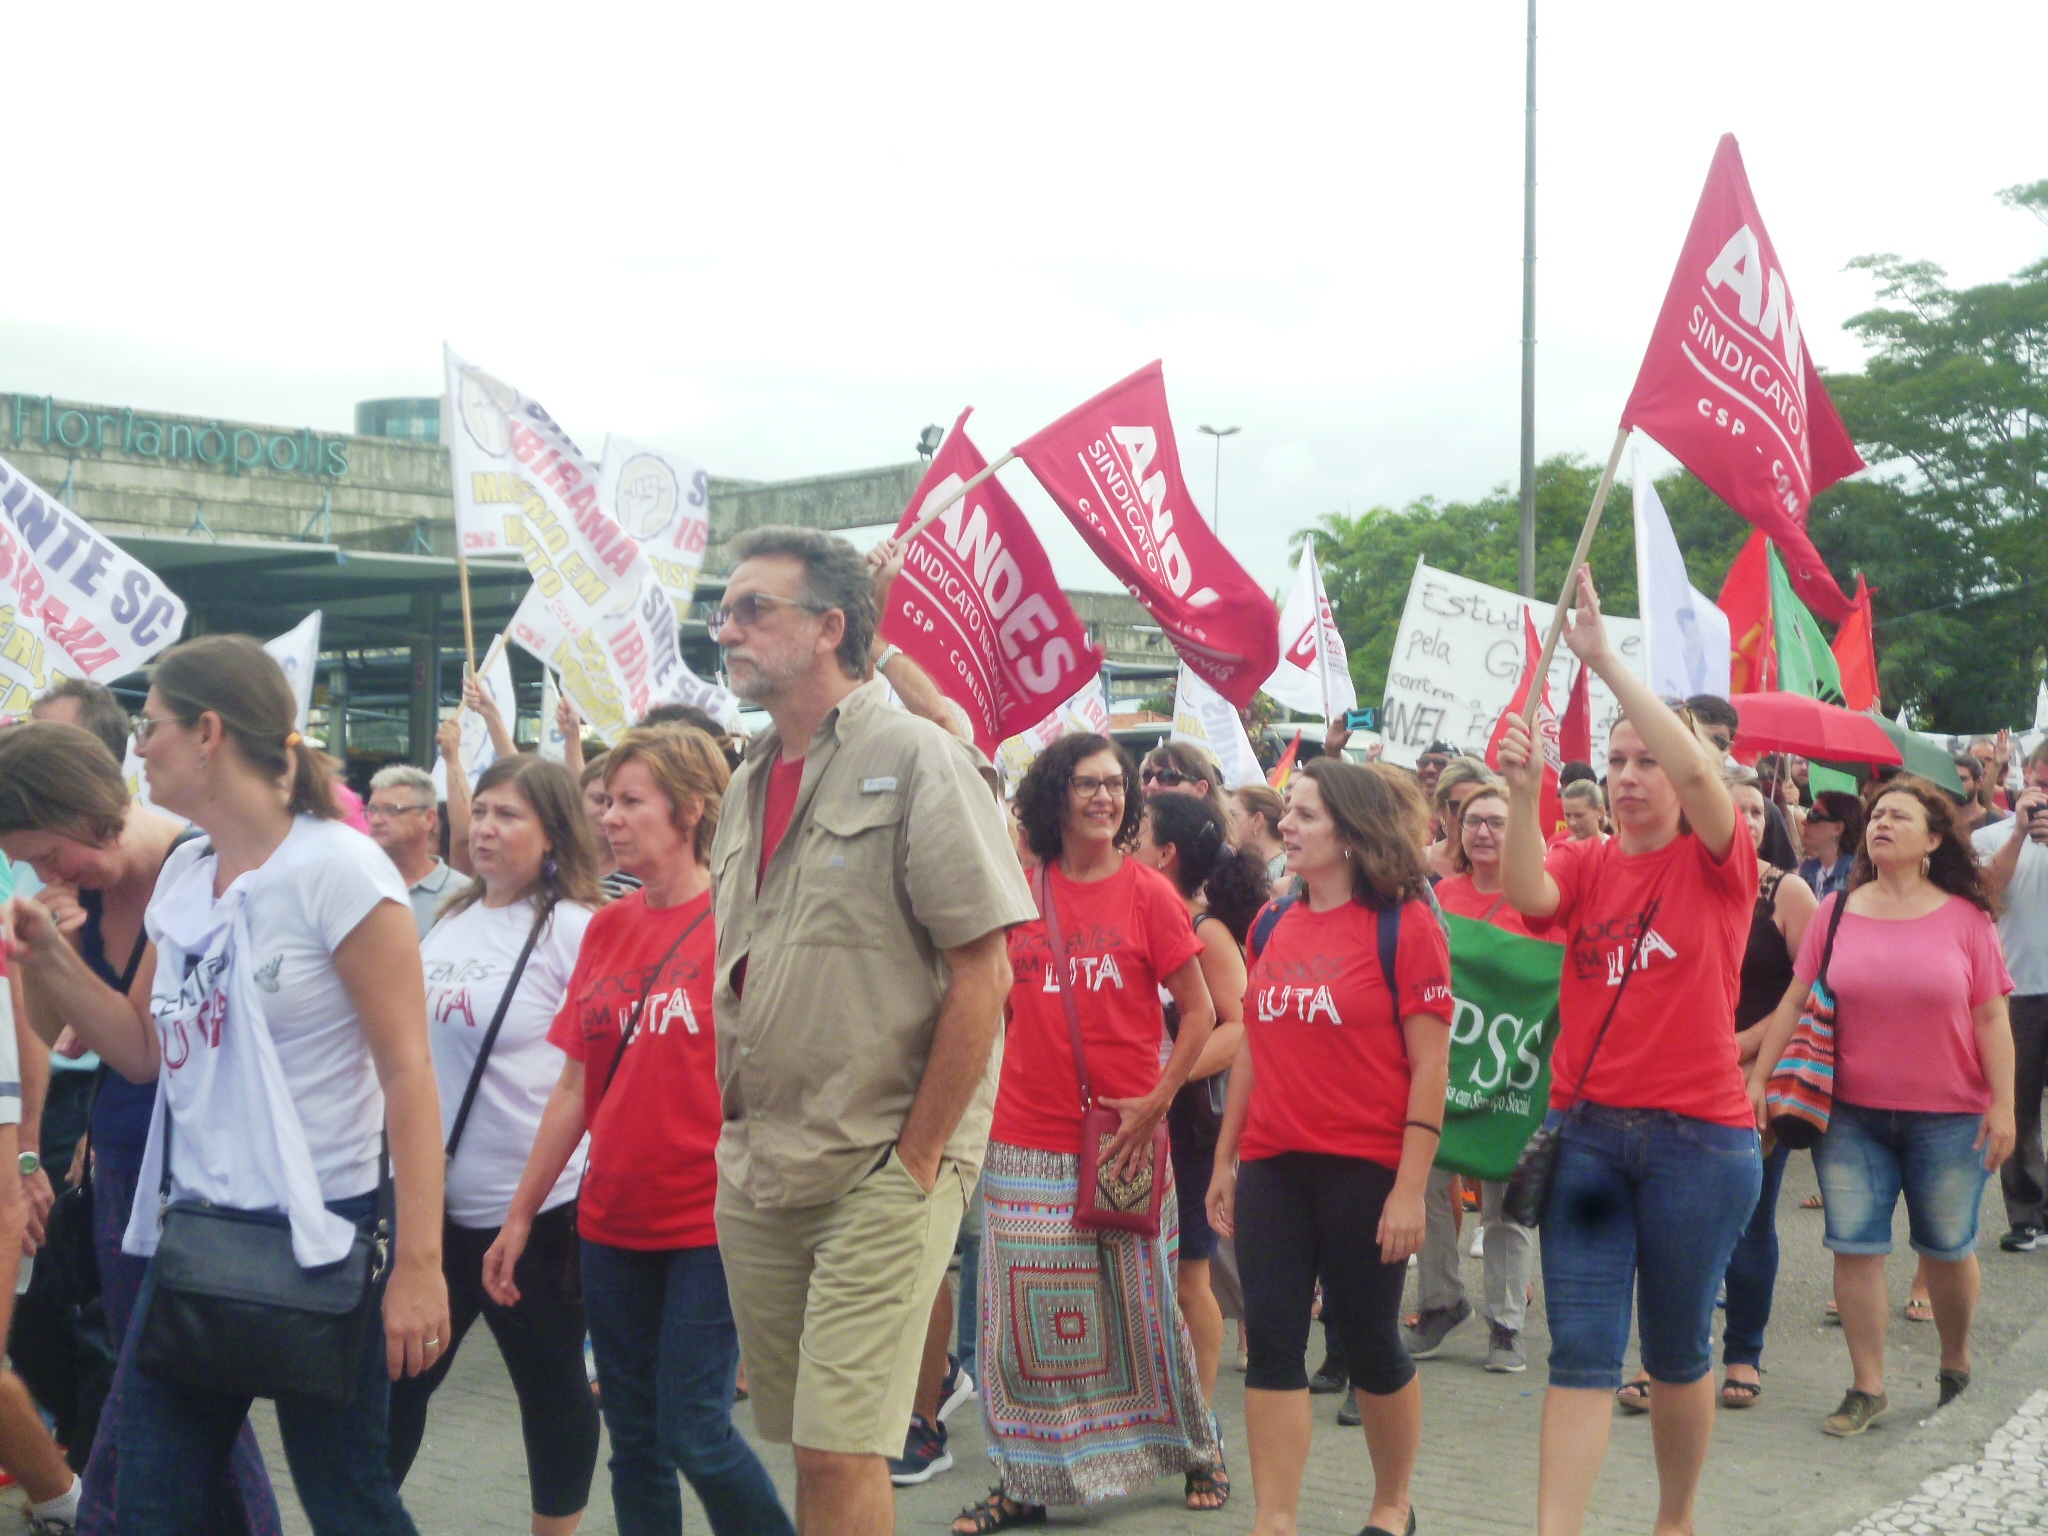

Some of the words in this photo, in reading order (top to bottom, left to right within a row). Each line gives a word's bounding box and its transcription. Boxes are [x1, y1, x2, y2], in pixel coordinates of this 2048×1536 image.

[1688, 304, 1800, 435] SINDICATO
[11, 394, 349, 478] Florianópolis
[1698, 398, 1746, 436] CSP
[1088, 440, 1158, 573] SINDICATO
[110, 569, 174, 647] SC
[1406, 627, 1450, 665] pela
[902, 601, 934, 632] CSP
[949, 650, 993, 735] CONLUTAS
[1392, 671, 1454, 700] contra
[1257, 984, 1343, 1026] LUTA
